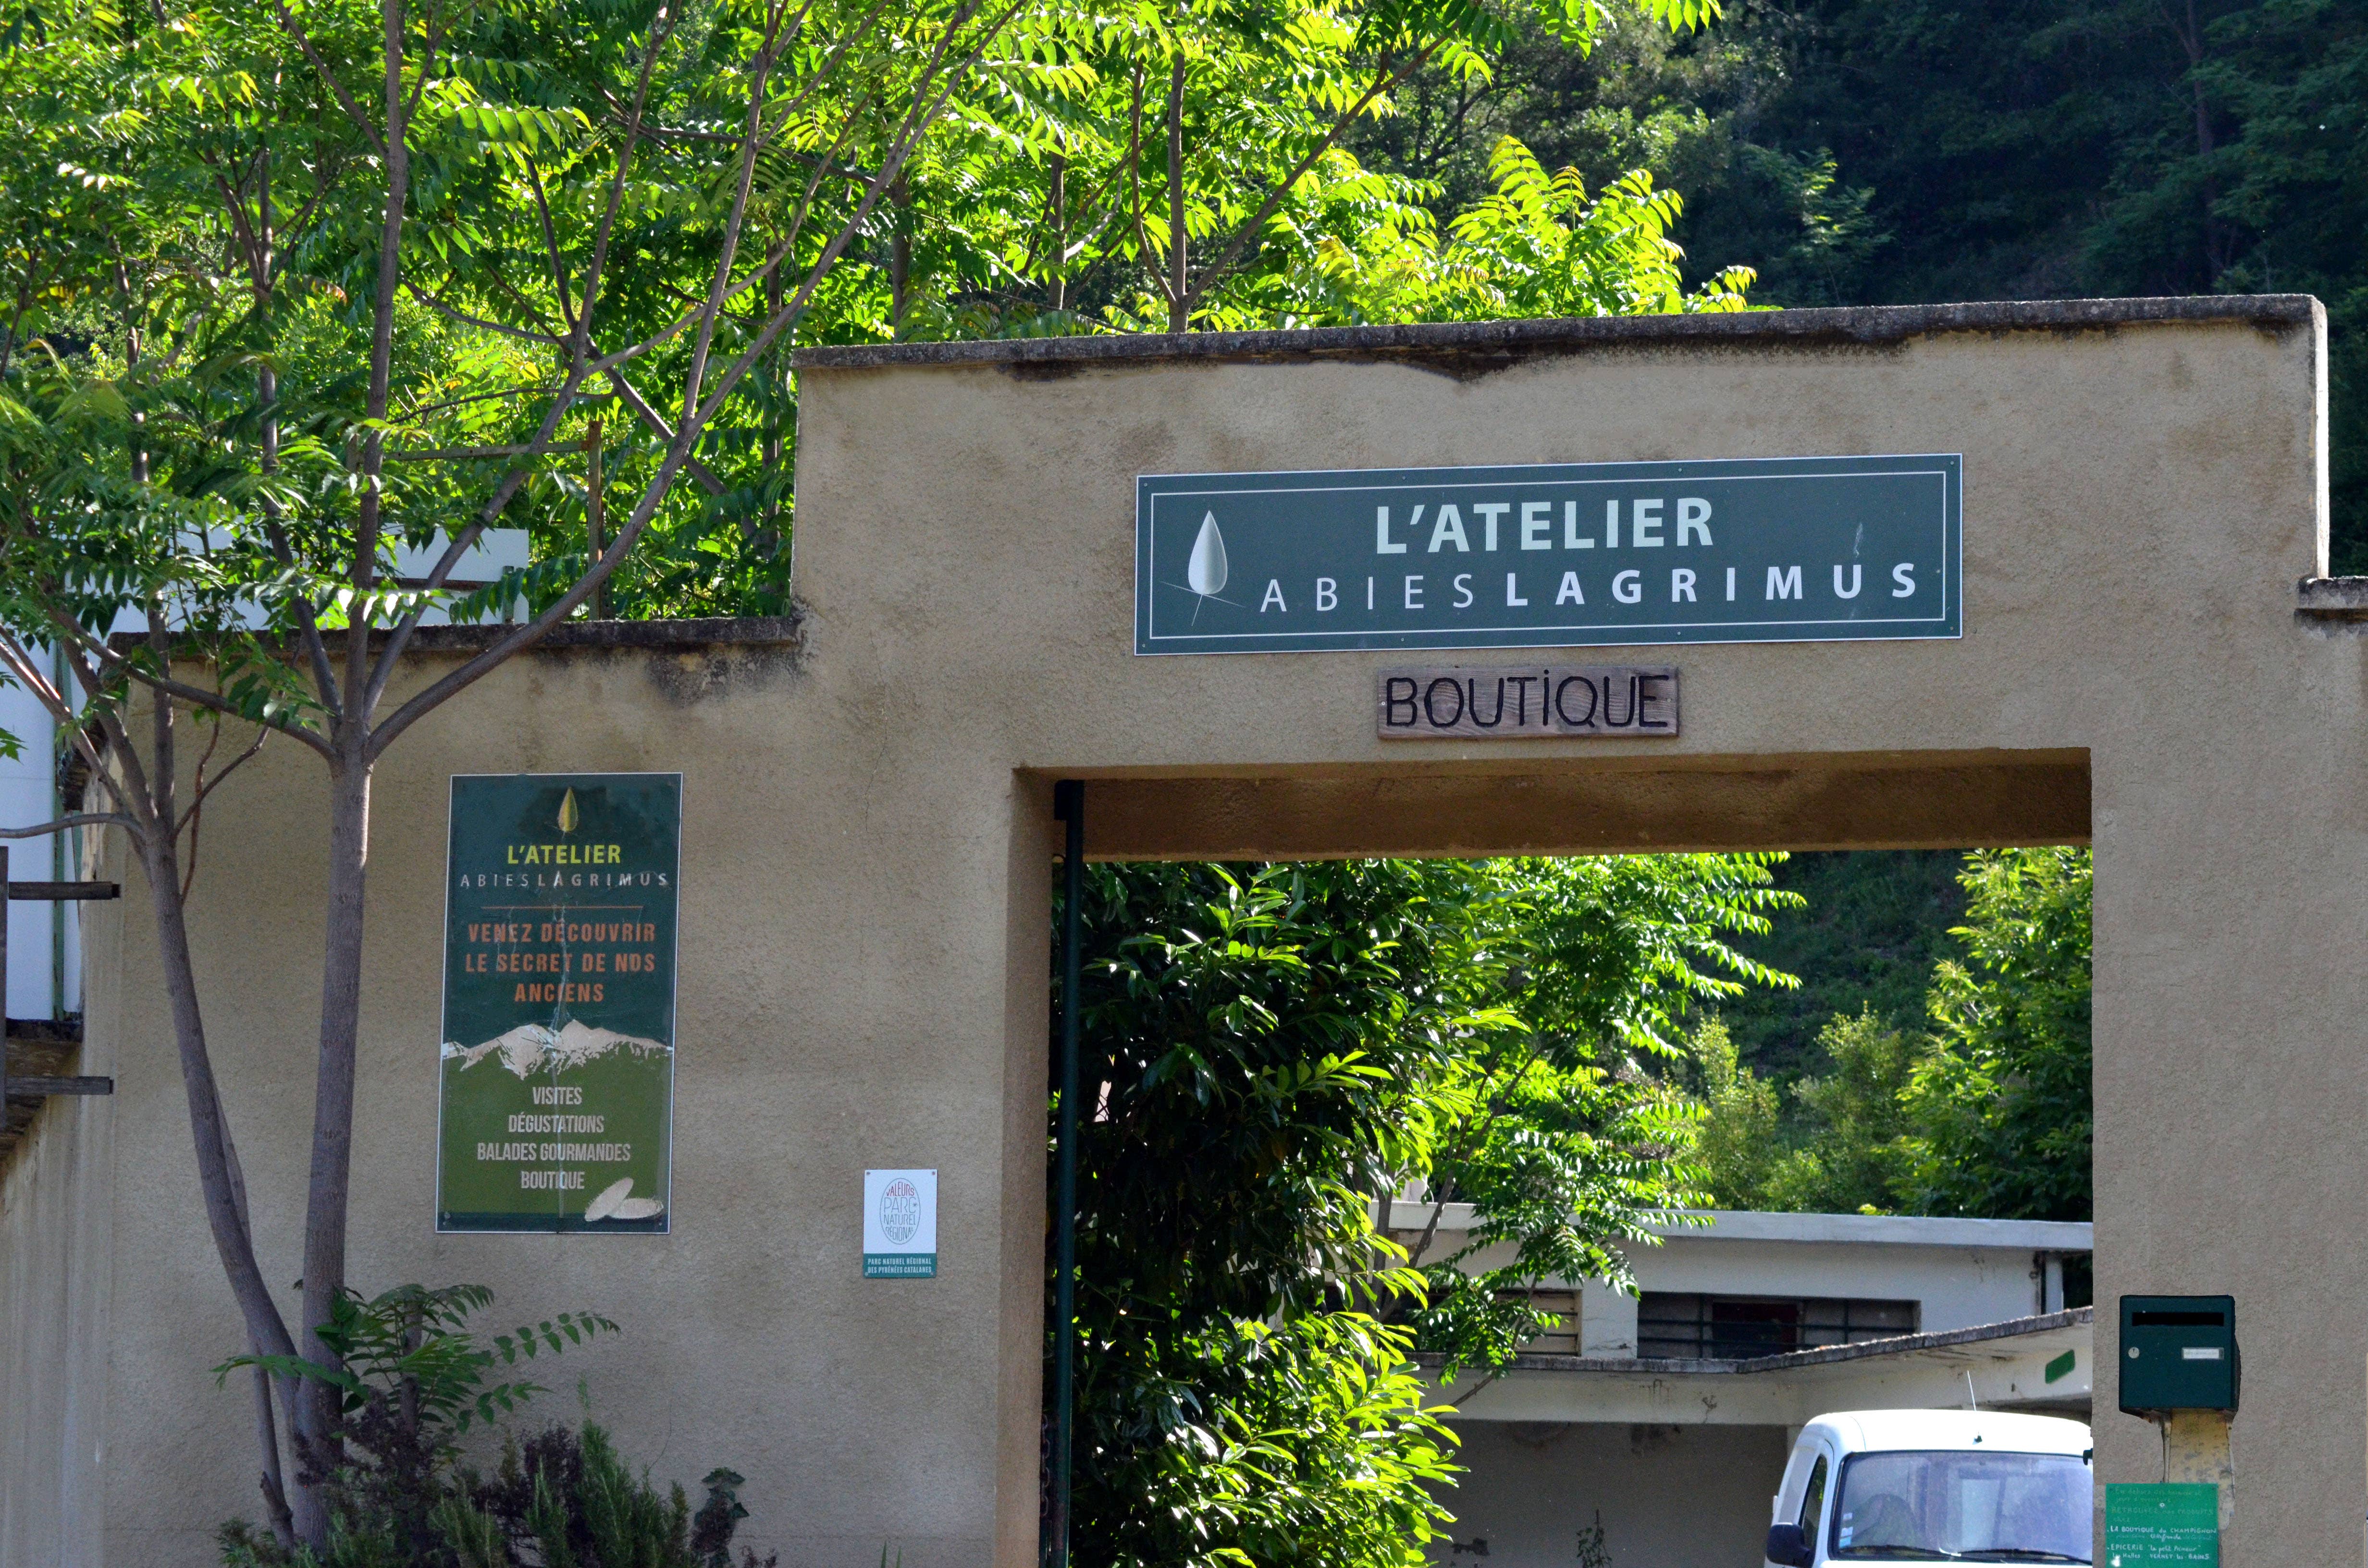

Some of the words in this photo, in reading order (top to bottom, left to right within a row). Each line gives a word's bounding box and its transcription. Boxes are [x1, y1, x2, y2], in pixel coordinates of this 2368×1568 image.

[1376, 497, 1714, 555] L'ATELIER
[507, 844, 621, 865] L'ATELIER
[468, 923, 532, 943] VENEZ
[541, 919, 655, 943] DÉCOUVRIR
[465, 953, 487, 973] LE
[497, 953, 573, 973] SECRET
[581, 953, 605, 972] DE
[615, 953, 655, 972] NOS
[515, 983, 604, 1003] ANCIENS
[532, 1087, 582, 1105] VISITES
[508, 1112, 604, 1133] DÉGUSTATIONS
[477, 1142, 537, 1161] BALADES
[540, 1142, 631, 1162] GOURMANDES
[520, 1171, 585, 1189] BOUTIQUE
[886, 1181, 915, 1197] VALEURS
[883, 1197, 917, 1214] PARC
[884, 1213, 916, 1225] NATUREL
